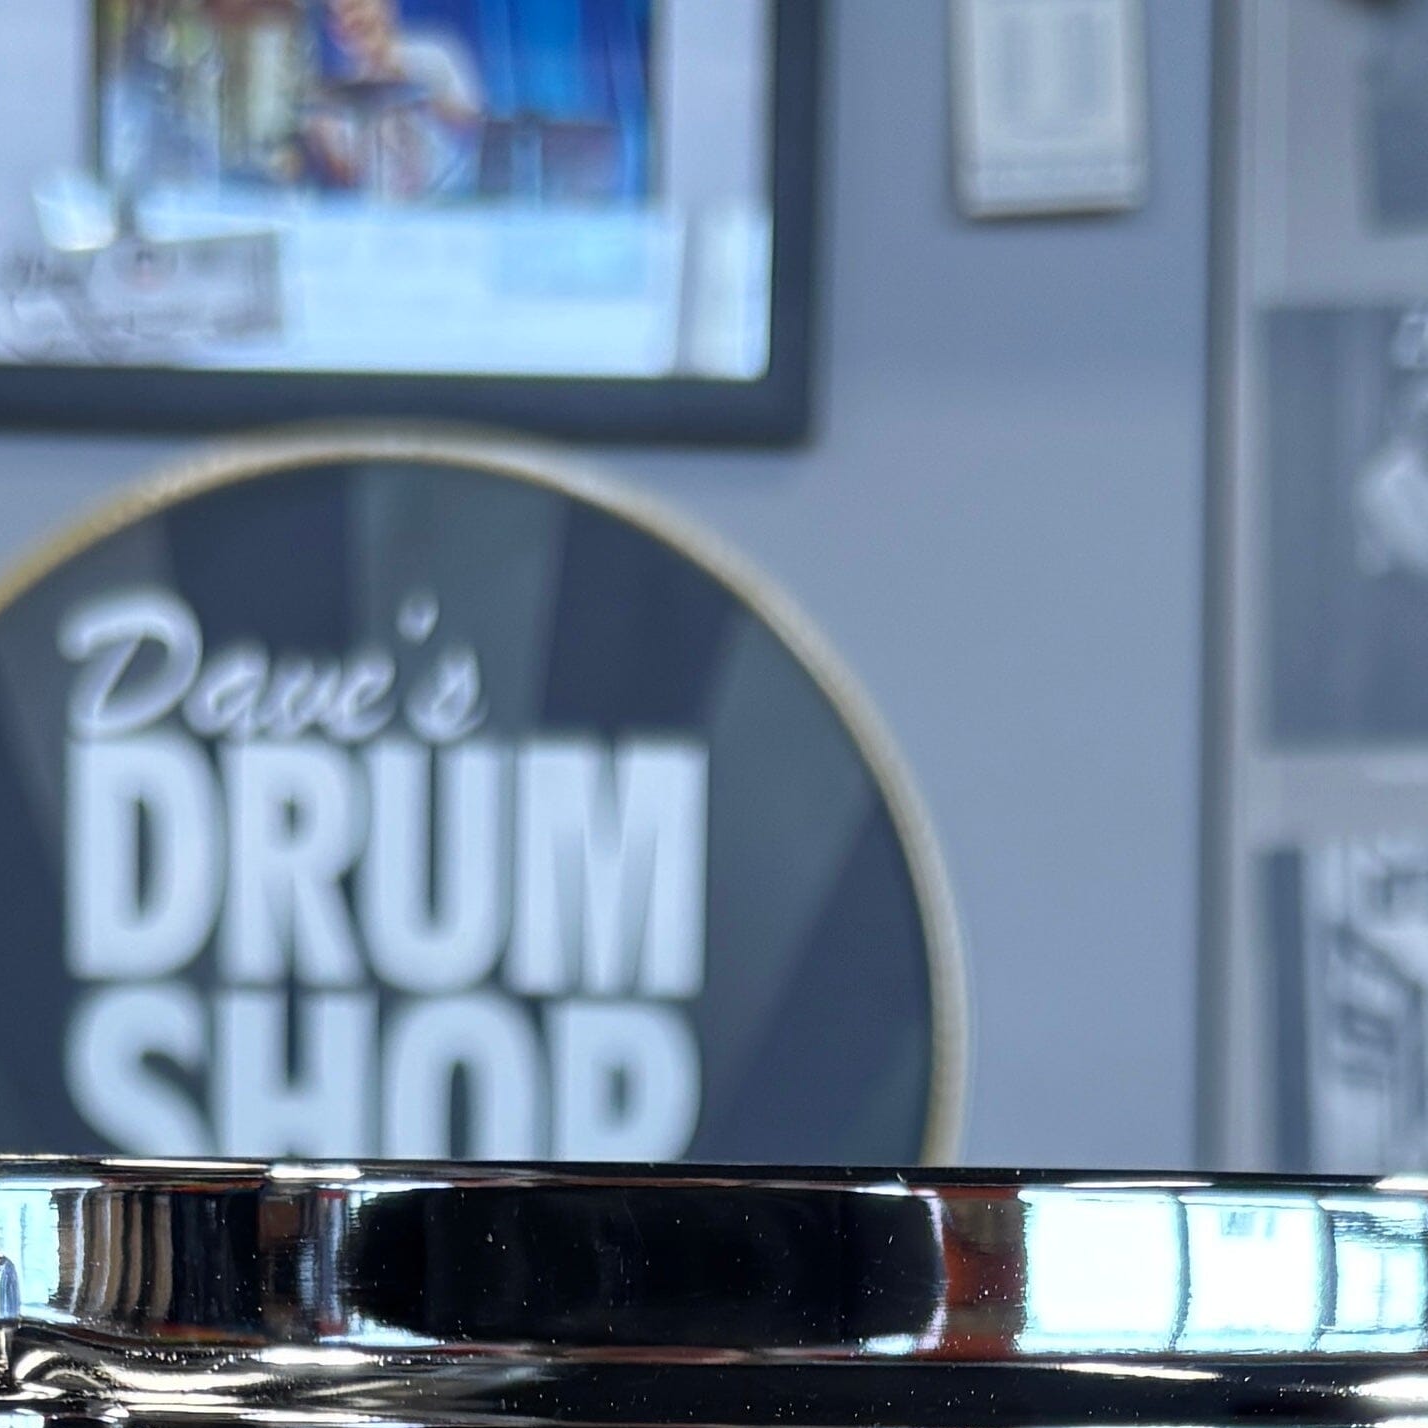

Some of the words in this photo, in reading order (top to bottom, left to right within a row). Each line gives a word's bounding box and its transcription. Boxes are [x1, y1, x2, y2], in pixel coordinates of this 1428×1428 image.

[58, 587, 489, 742] Dave's
[64, 735, 710, 998] DRUM
[62, 984, 704, 1158] SHOP
